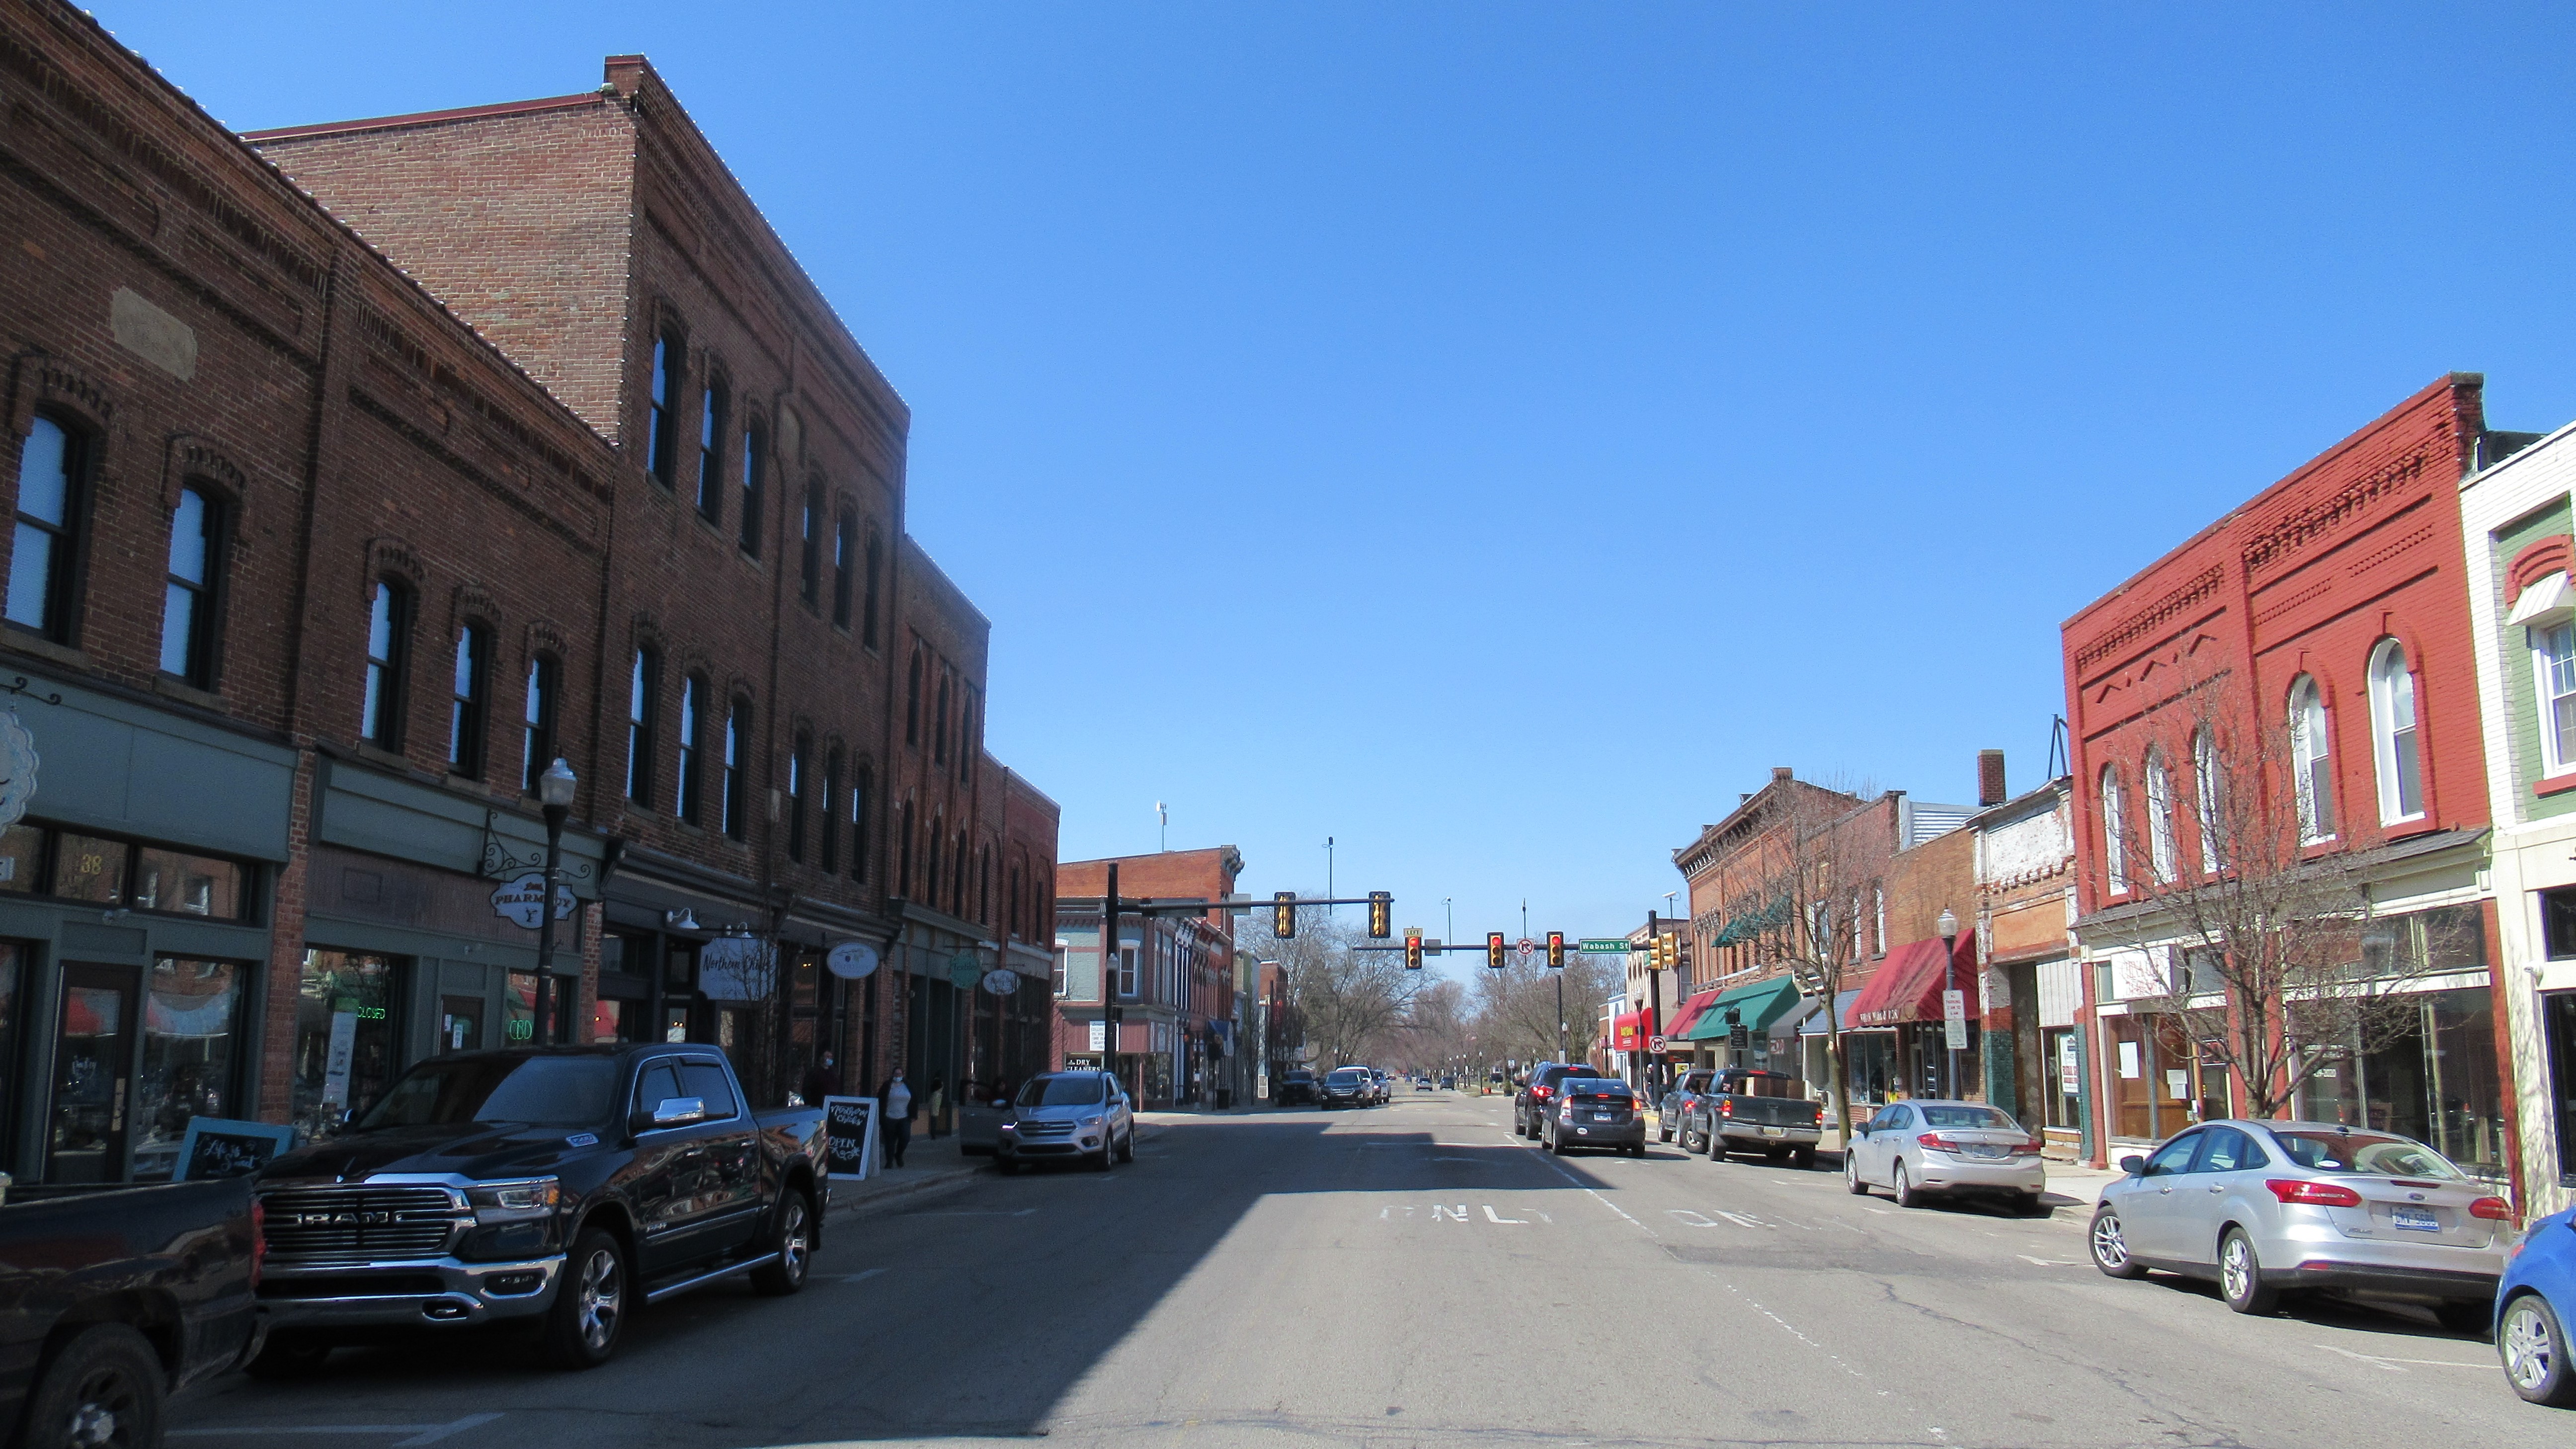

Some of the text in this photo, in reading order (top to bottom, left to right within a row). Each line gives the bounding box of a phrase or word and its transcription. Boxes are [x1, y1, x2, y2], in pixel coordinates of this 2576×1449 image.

[80, 853, 102, 875] 38
[495, 894, 571, 907] PHARMCY
[509, 1020, 532, 1040] CBD
[828, 1135, 856, 1148] OPEN
[305, 1211, 389, 1225] RAM
